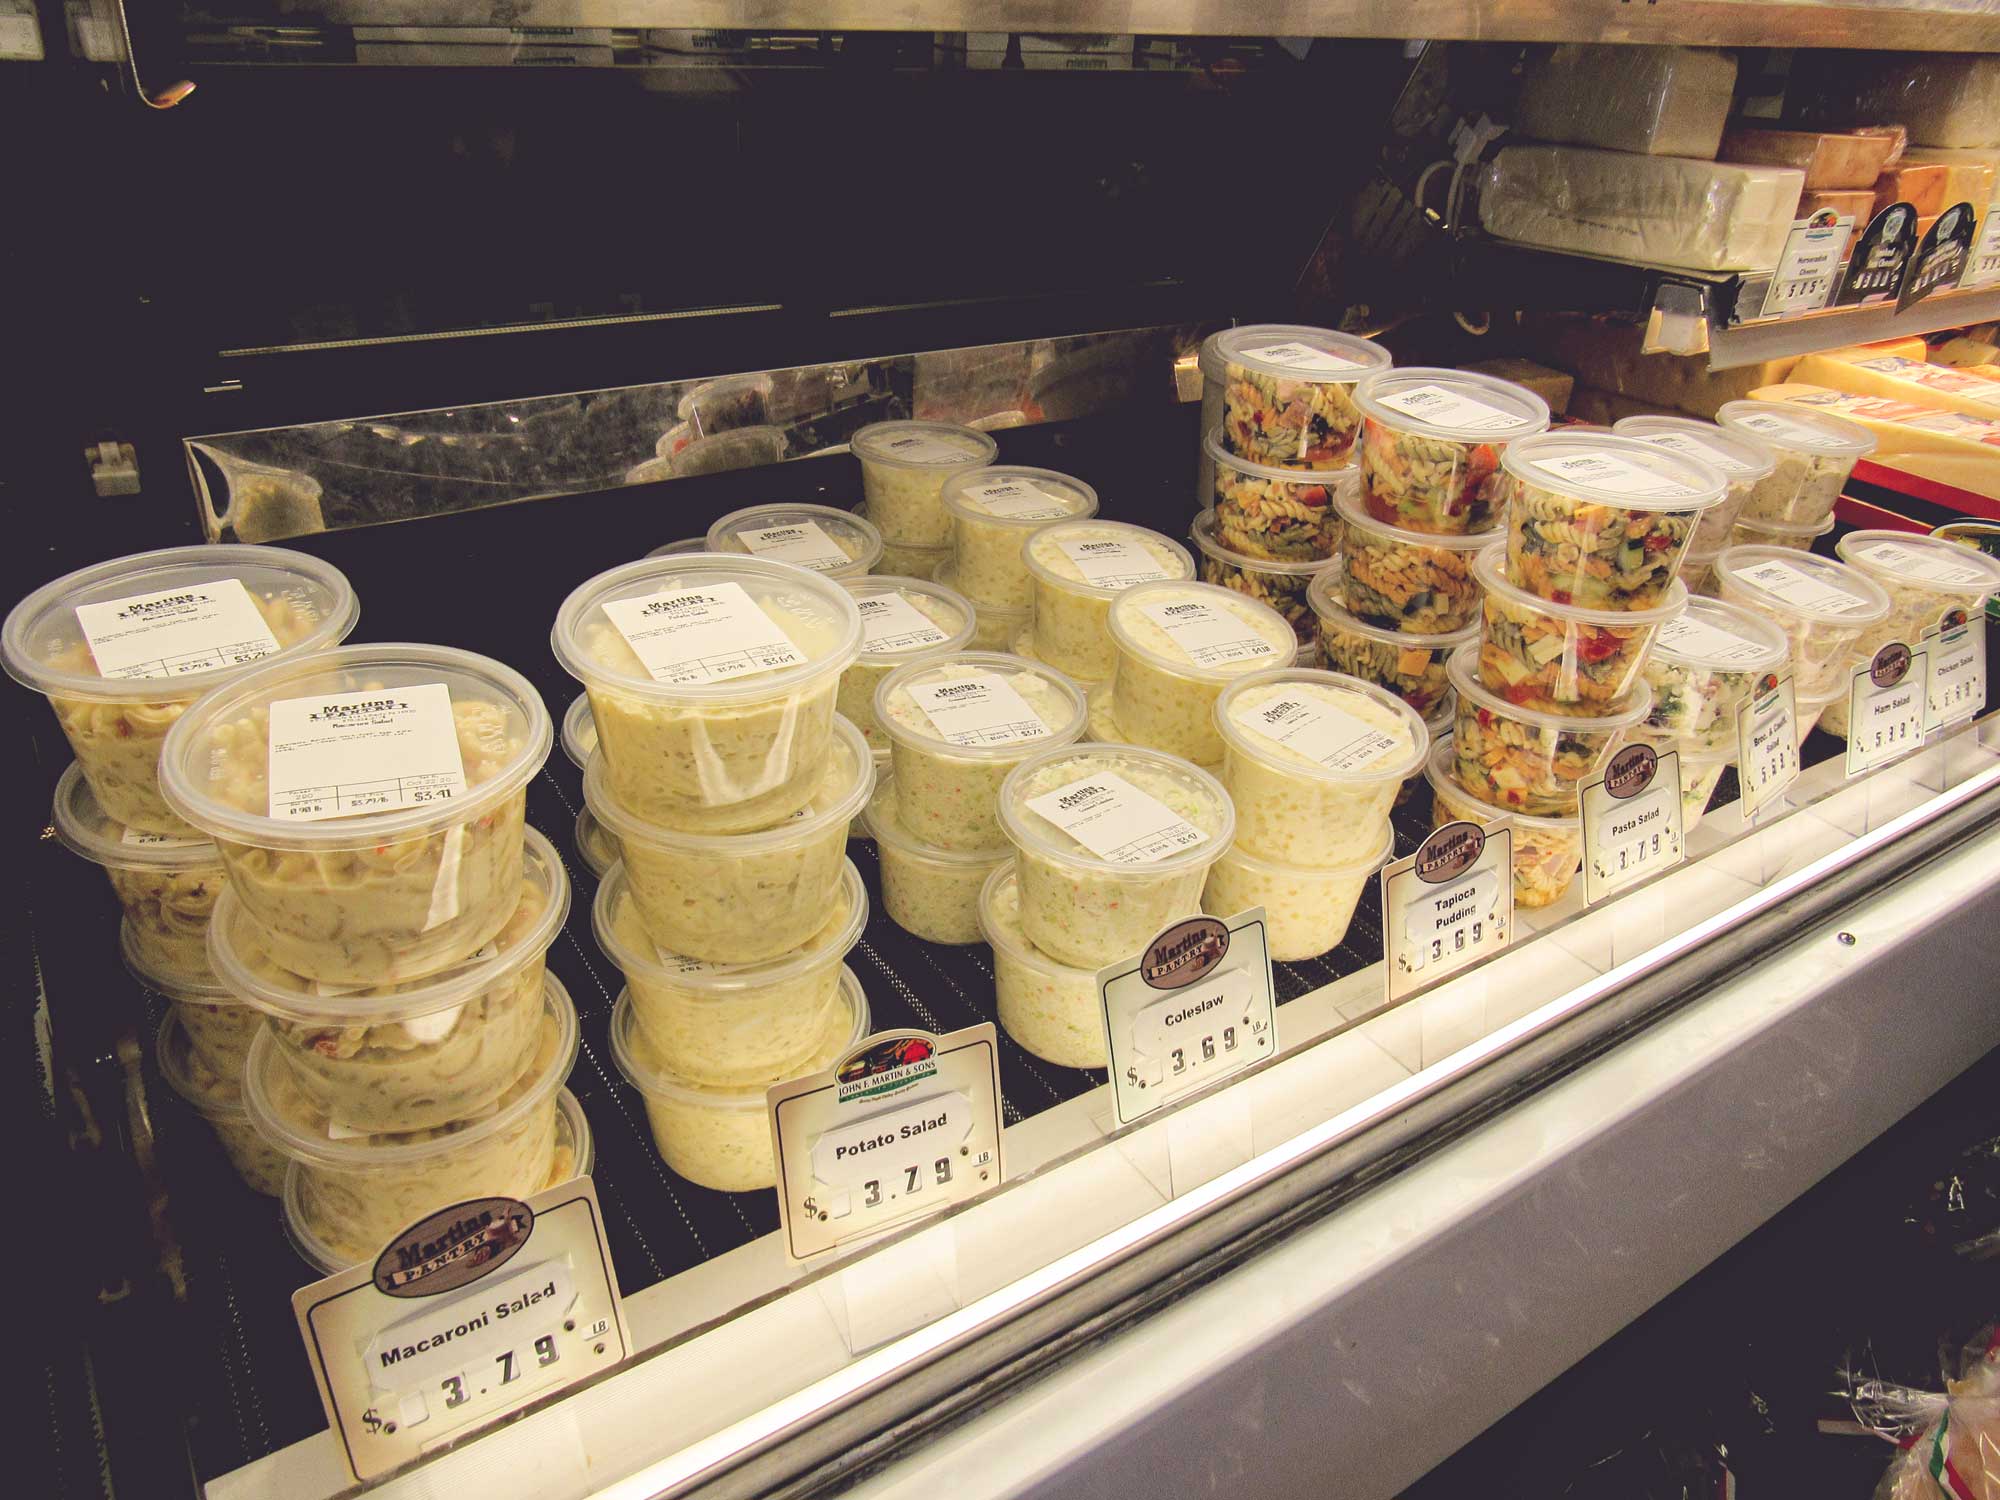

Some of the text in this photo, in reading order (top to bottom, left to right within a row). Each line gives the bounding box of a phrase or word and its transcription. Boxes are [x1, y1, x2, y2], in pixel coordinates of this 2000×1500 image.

[323, 699, 395, 714] Martins
[1874, 694, 1911, 715] Ham Salad
[1612, 807, 1660, 837] Pasta Salad
[1426, 830, 1469, 862] Martins
[1426, 845, 1465, 871] PANTRY
[1435, 887, 1477, 912] Tapioca
[1435, 904, 1478, 930] Pudding
[1154, 926, 1208, 967] Martins
[1156, 944, 1204, 976] PANTRY
[1398, 952, 1407, 972] $
[1432, 921, 1483, 961] 3.69
[1165, 994, 1225, 1028] Coleslaw
[1127, 1066, 1138, 1088] $
[1171, 1026, 1239, 1075] 3.69
[838, 1080, 862, 1098] JOHN
[863, 1078, 870, 1090] F.
[871, 1068, 904, 1088] MARTIN
[905, 1067, 912, 1077] &
[913, 1060, 937, 1075] SONS
[835, 1112, 948, 1161] Potato Salad
[803, 1151, 990, 1221] $ 3.79 LB
[397, 1209, 494, 1266] Martins
[404, 1231, 488, 1282] PANTRY
[380, 1281, 557, 1369] Macaroni Salad
[361, 1319, 608, 1436] $ 3.79 LB
